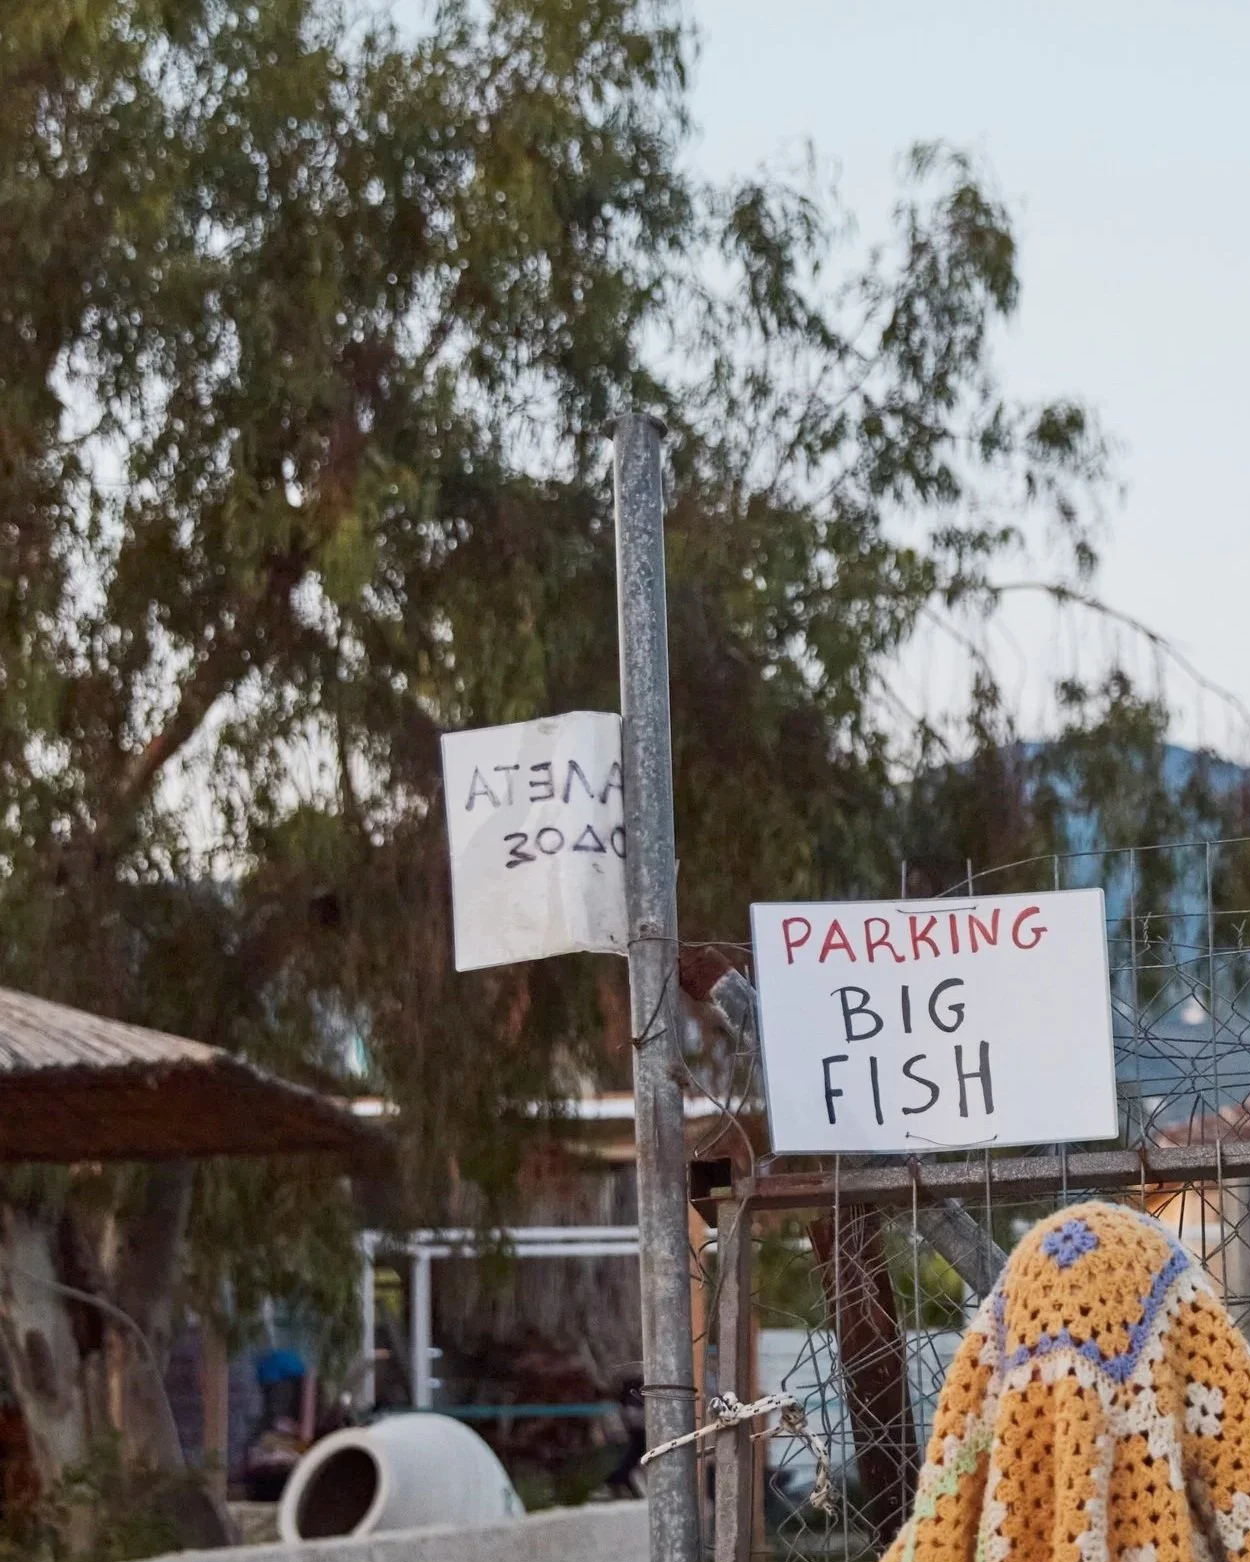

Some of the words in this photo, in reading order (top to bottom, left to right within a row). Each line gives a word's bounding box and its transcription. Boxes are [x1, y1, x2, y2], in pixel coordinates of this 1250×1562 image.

[782, 905, 1048, 965] PARKING
[830, 977, 965, 1044] BIG
[822, 1040, 994, 1125] FISH
